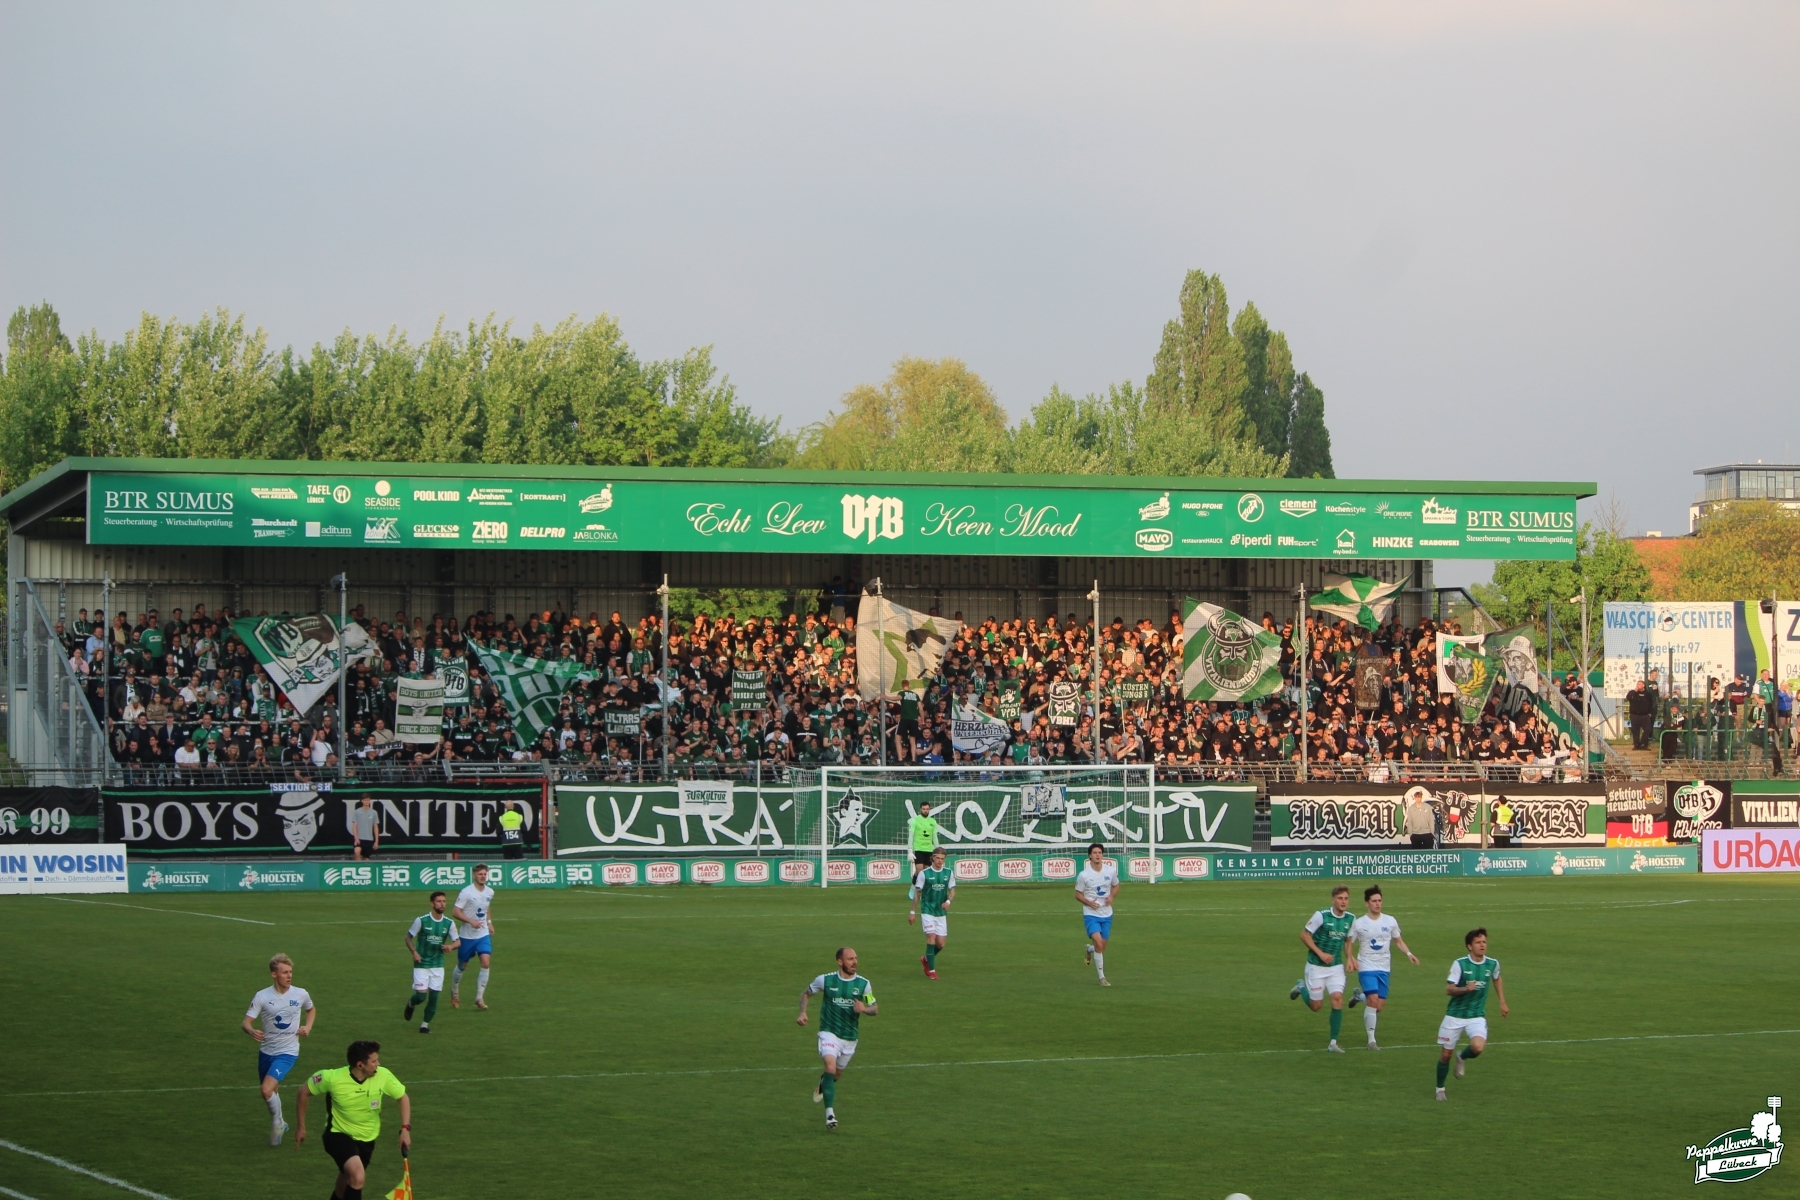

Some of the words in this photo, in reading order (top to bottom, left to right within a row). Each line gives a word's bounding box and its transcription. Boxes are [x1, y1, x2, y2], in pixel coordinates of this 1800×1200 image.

[307, 485, 331, 495] TAFEL
[104, 491, 150, 509] BTR
[156, 492, 234, 510] SUMUS
[364, 498, 400, 506] SEASIDE
[1280, 499, 1317, 509] clement
[1325, 505, 1366, 514] Küchenstyle
[104, 517, 157, 527] Steuerberatung
[165, 518, 233, 528] Wirtschaftsprüfung
[686, 502, 752, 536] Echt
[761, 501, 827, 536] Leev
[840, 493, 904, 545] VfB
[921, 502, 994, 537] Keen
[1000, 503, 1082, 537] Mood
[1467, 511, 1504, 527] BTR
[1509, 512, 1574, 528] SUMUS
[321, 525, 352, 534] aditum
[472, 521, 508, 539] ZERO
[520, 527, 566, 538] DELLPRO
[573, 532, 618, 540] JABLONKA
[1139, 533, 1169, 544] MAYO
[1242, 534, 1272, 548] iperdi
[1466, 535, 1511, 544] Steuerberatung
[1517, 535, 1573, 544] Wirtschaftsprüfung
[1372, 537, 1414, 548] HINZKE
[1606, 611, 1656, 629] WASCH
[1682, 611, 1733, 629] CENTER
[400, 687, 418, 697] BOYS
[420, 687, 442, 698] UNITED
[1122, 683, 1149, 691] KÜSTEN
[1122, 691, 1143, 699] JUNGS
[604, 712, 640, 724] ULTRAS
[399, 725, 418, 733] SINCE
[420, 725, 437, 733] 2002
[271, 783, 310, 792] SEKTION
[1608, 786, 1643, 802] sektion
[1607, 797, 1647, 812] neustadt
[1678, 793, 1699, 810] VfB
[1741, 800, 1798, 823] VITALIEN
[30, 807, 70, 835] 99
[117, 801, 259, 841] BOYS
[341, 799, 533, 837] UNITED
[1631, 813, 1654, 837] VfB
[504, 830, 519, 840] 154
[33, 855, 125, 874] WOISIN
[1216, 858, 1324, 868] KENSINGTON
[1332, 855, 1354, 865] IHRE
[1356, 853, 1460, 865] IMMOBILIENEXPERTEN
[1492, 859, 1527, 869] HOLSTEN
[1568, 858, 1606, 867] HOLSTEN
[1648, 857, 1686, 866] HOLSTEN
[1047, 861, 1071, 869] MAYO
[1332, 866, 1343, 875] IN
[1345, 866, 1364, 875] DER
[1366, 863, 1414, 875] LÜBECKER
[1416, 864, 1450, 874] BUCHT.
[165, 874, 210, 884] HOLSTEN
[260, 873, 305, 883] HOLSTEN
[341, 867, 372, 880] FLS
[382, 869, 410, 883] 30
[436, 866, 466, 879] FLS
[486, 868, 502, 882] 0
[528, 866, 557, 878] FLS
[566, 867, 592, 881] 30
